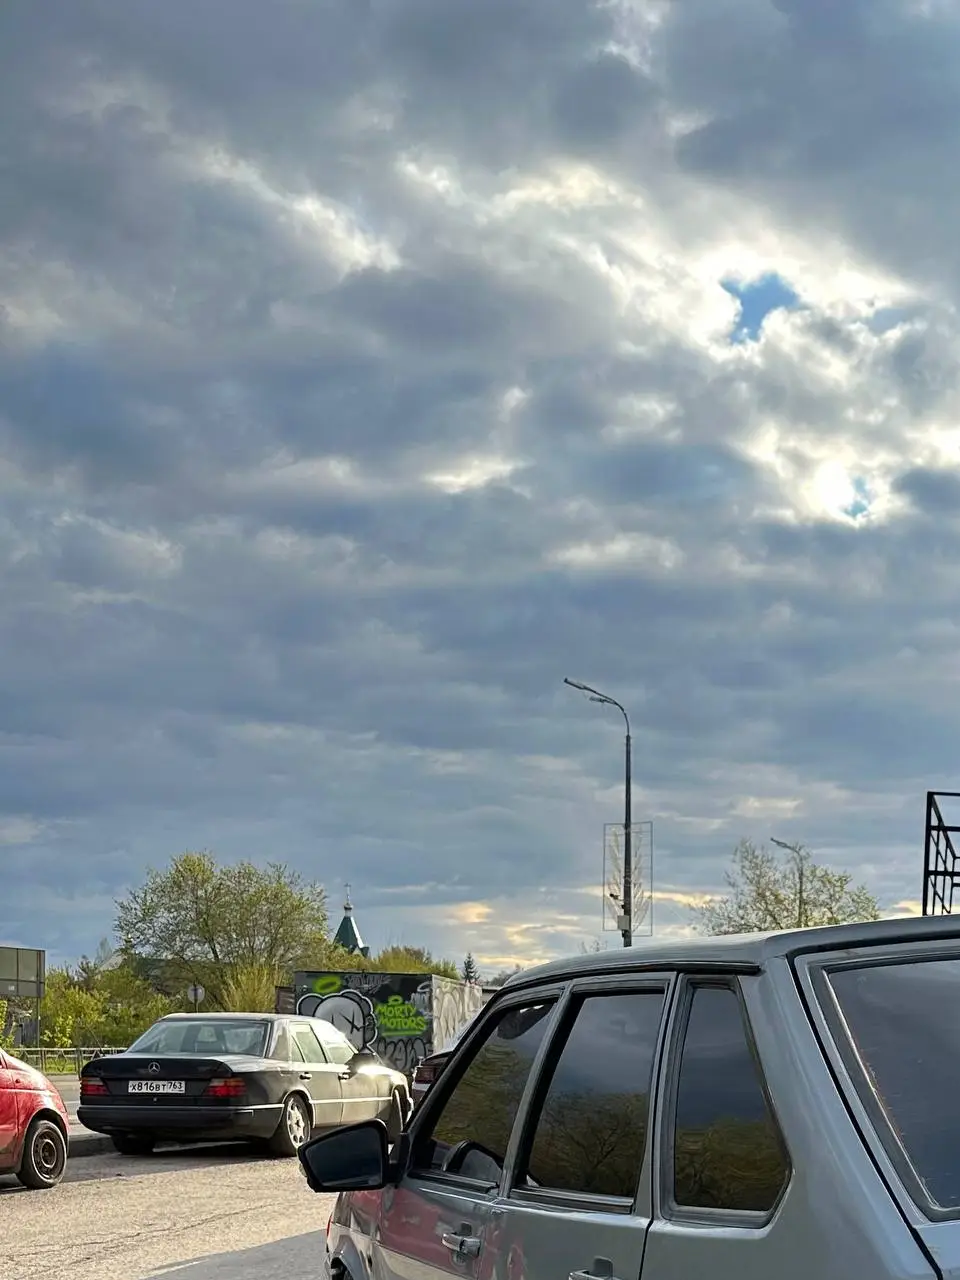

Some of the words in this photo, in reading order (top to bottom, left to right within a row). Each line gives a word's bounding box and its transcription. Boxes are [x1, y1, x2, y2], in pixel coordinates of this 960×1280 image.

[376, 1003, 417, 1018] MORTY
[379, 1017, 428, 1031] MOTORS
[167, 1081, 182, 1090] 763
